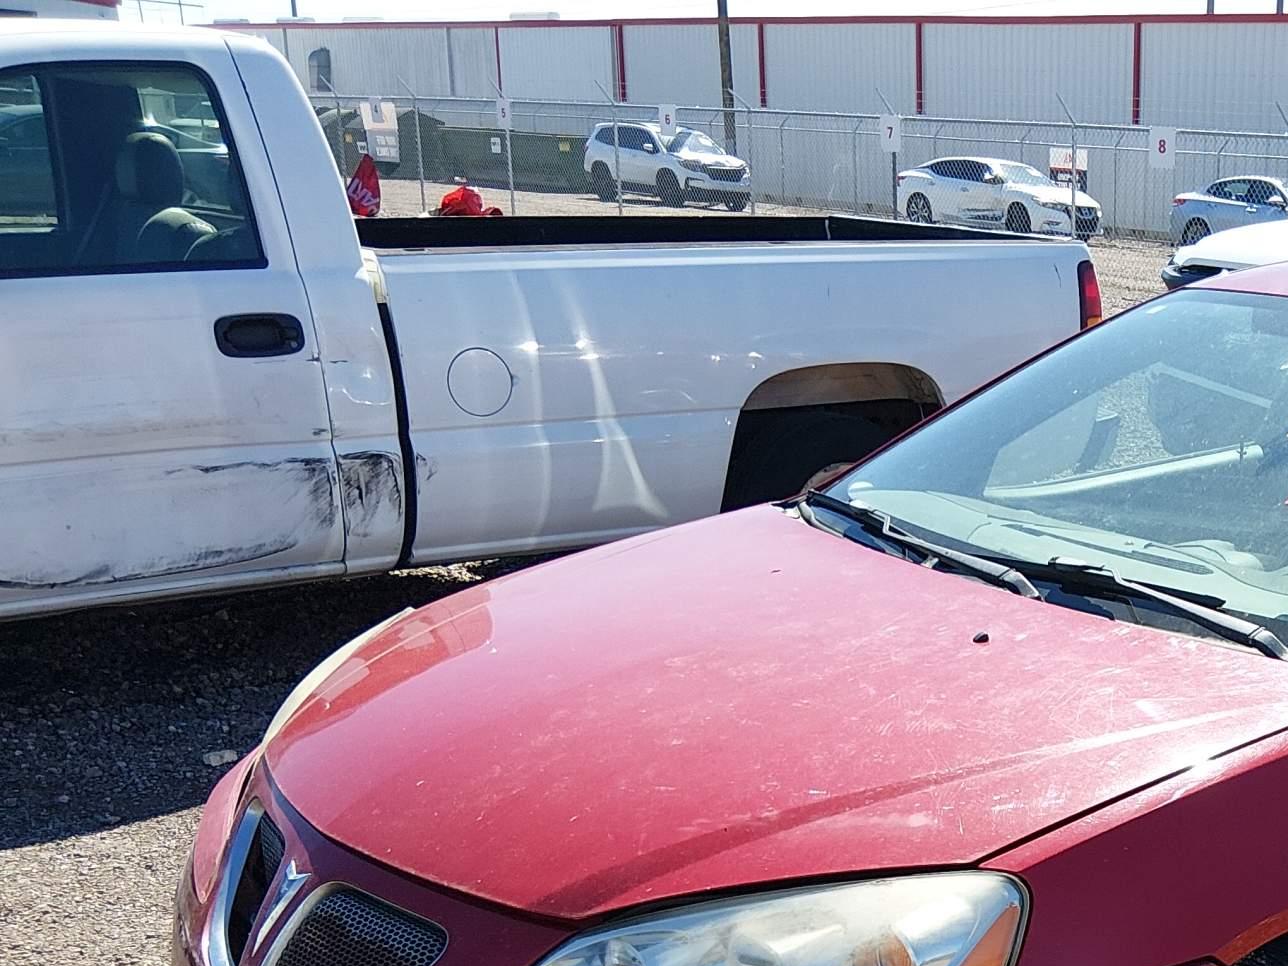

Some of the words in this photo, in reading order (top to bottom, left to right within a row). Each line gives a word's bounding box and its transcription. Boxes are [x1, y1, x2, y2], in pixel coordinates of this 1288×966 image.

[501, 107, 506, 118] 5
[664, 113, 671, 125] 6
[886, 126, 894, 139] 7
[1157, 139, 1167, 154] 8
